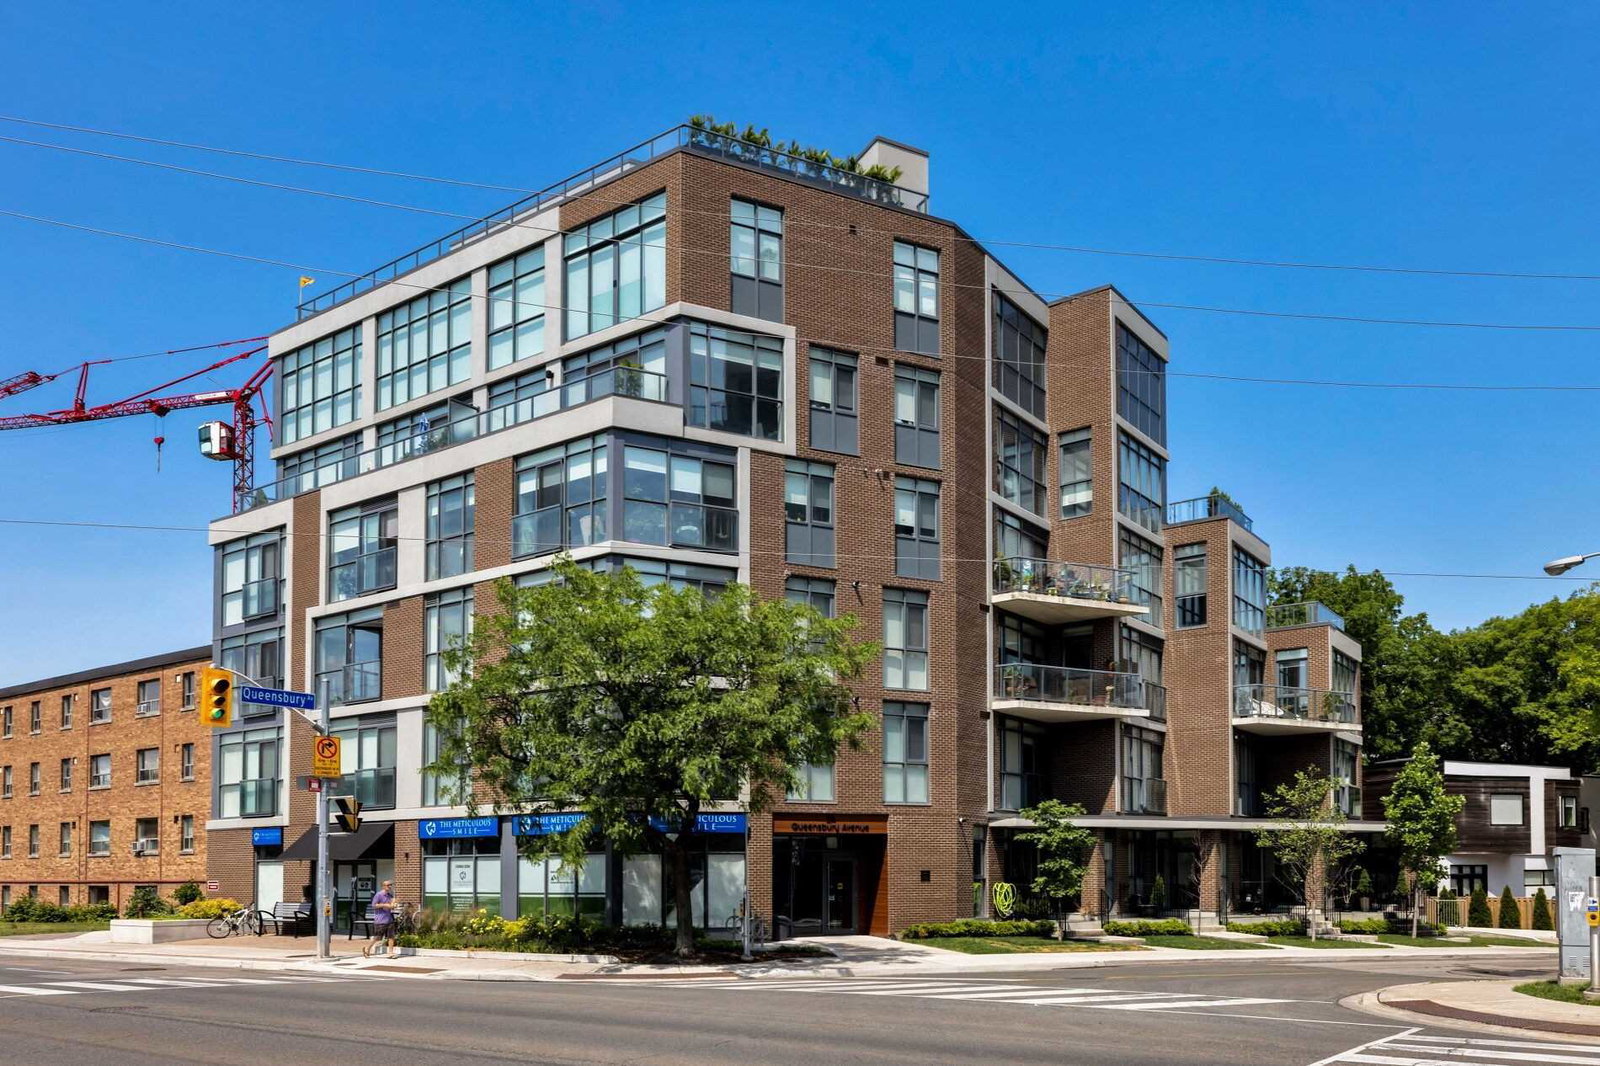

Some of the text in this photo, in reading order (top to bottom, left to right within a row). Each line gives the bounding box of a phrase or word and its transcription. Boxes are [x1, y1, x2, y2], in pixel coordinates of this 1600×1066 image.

[243, 687, 306, 708] Queensbury
[439, 818, 491, 829] THE METICULOUS
[698, 815, 737, 823] ICULOUS
[452, 827, 478, 835] SMILE
[697, 823, 717, 831] ILE
[791, 822, 870, 833] Queensbury Avenue
